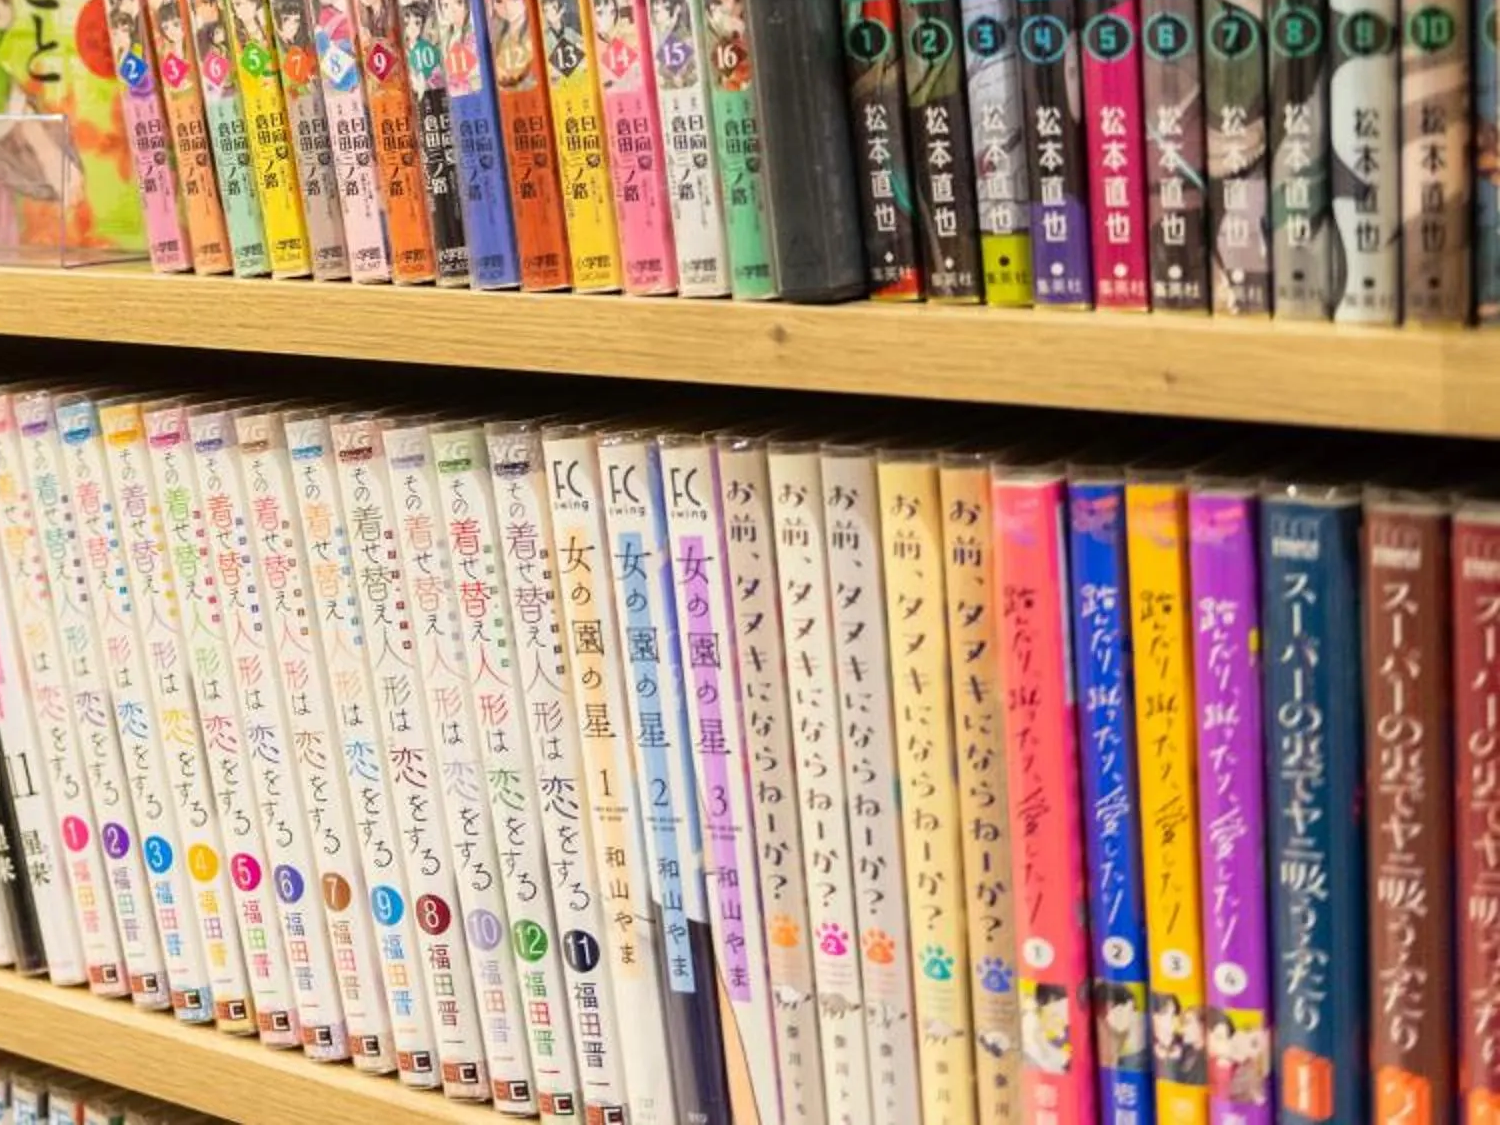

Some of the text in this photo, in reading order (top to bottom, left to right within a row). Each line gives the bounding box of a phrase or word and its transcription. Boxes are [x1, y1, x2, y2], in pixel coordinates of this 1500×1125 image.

[864, 103, 897, 232] 松本直也
[925, 106, 957, 237] 松本直也
[981, 105, 1013, 236] 松本直也
[1036, 106, 1067, 242] 松本直也
[1100, 105, 1130, 244] 松本直也
[1157, 105, 1186, 246] 松本直也
[1221, 104, 1249, 239] 松本直也
[1284, 103, 1311, 246] 松本直也
[1355, 107, 1380, 252] 松本直也
[1421, 103, 1447, 253] 松本直也
[559, 535, 617, 738] 女の園の星
[614, 541, 670, 748] 女の園の星
[676, 545, 731, 755] 女の園の星
[4, 751, 38, 799] 11
[599, 769, 612, 796] 1
[652, 778, 669, 807] 2
[713, 786, 728, 817] 3
[604, 846, 636, 964] 和山やま
[658, 857, 691, 978] 和山やま
[717, 865, 751, 989] 和山やま
